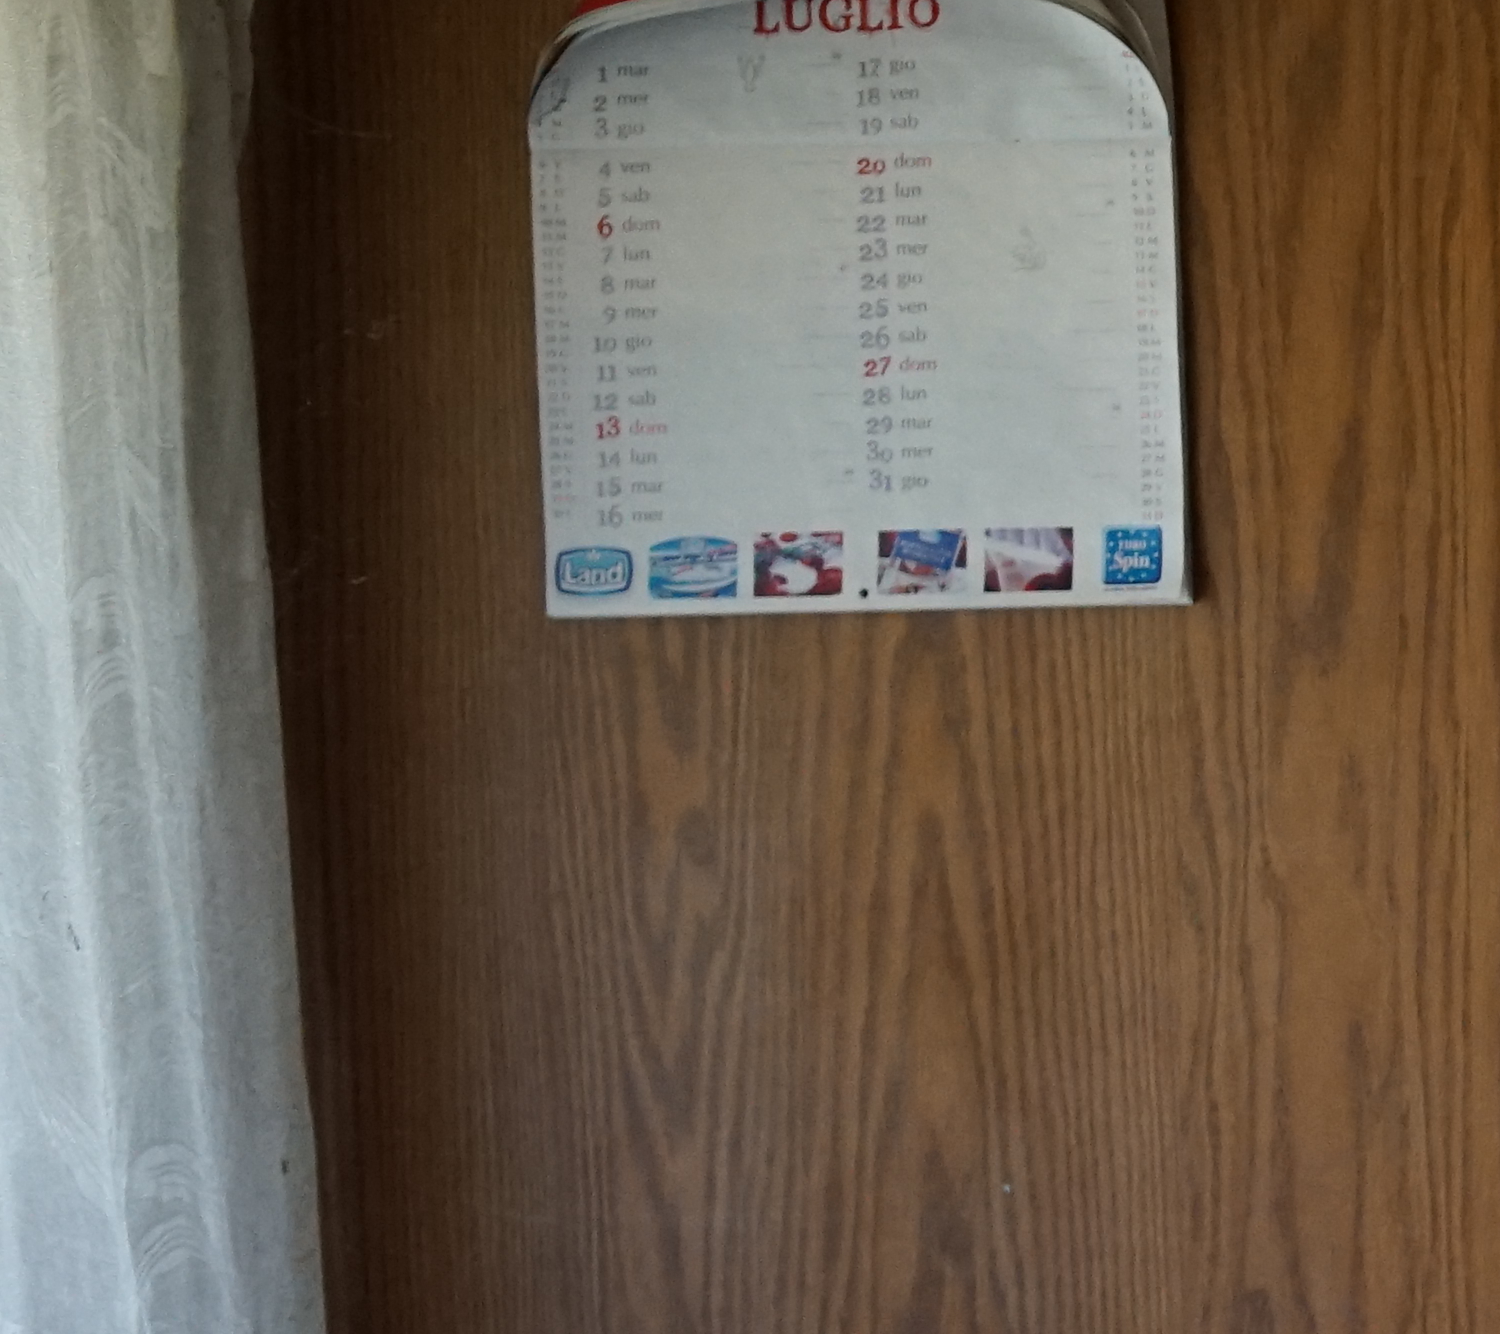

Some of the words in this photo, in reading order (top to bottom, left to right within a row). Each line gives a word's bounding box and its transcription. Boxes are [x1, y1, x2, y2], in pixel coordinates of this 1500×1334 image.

[598, 65, 606, 82] 1
[617, 65, 649, 77] mar
[858, 58, 882, 78] 17
[890, 59, 916, 75] gio
[593, 96, 607, 112] 2
[617, 94, 649, 105] mer
[857, 87, 881, 108] 18
[890, 88, 919, 100] ven
[595, 117, 608, 139] 3
[617, 123, 645, 139] gio
[859, 117, 882, 135] 19
[890, 114, 919, 129] sab
[599, 160, 611, 178] 4
[620, 161, 650, 173] ven
[856, 157, 886, 176] 20
[894, 153, 932, 168] dom
[597, 187, 611, 207] 5
[622, 187, 650, 202] sab
[860, 187, 885, 204] 21
[895, 182, 922, 198] lun
[597, 213, 613, 240] 6
[622, 216, 661, 232] dom
[856, 215, 886, 233] 22
[895, 214, 928, 226] mar
[602, 246, 614, 265] 7
[624, 246, 650, 261] lun
[859, 238, 888, 262] 23
[897, 244, 928, 255] mer
[600, 275, 615, 295] 8
[624, 277, 656, 291] mar
[861, 273, 888, 291] 24
[897, 274, 922, 288] gio
[602, 305, 616, 324] 9
[625, 306, 658, 319] mer
[858, 298, 889, 320] 25
[898, 301, 927, 314] ven
[593, 336, 617, 353] 10
[626, 337, 652, 353] gio
[860, 326, 890, 349] 26
[899, 326, 927, 342] sab
[598, 365, 616, 382] 11
[627, 365, 657, 376] ven
[863, 356, 892, 377] 27
[899, 356, 937, 371] dom
[593, 393, 618, 411] 12
[628, 390, 656, 406] sab
[863, 386, 891, 406] 28
[901, 385, 927, 400] lun
[595, 415, 621, 440] 13
[629, 419, 668, 435] dom
[866, 416, 892, 435] 29
[901, 417, 933, 429] mar
[599, 451, 620, 468] 14
[630, 448, 657, 464] lun
[867, 440, 893, 463] 30
[901, 446, 933, 458] mer
[597, 476, 622, 498] 15
[631, 480, 663, 493] mar
[869, 469, 892, 491] 31
[902, 475, 928, 491] gio
[598, 505, 623, 528] 16
[632, 508, 663, 521] mer
[565, 559, 626, 585] Land
[1109, 551, 1150, 573] Spin
